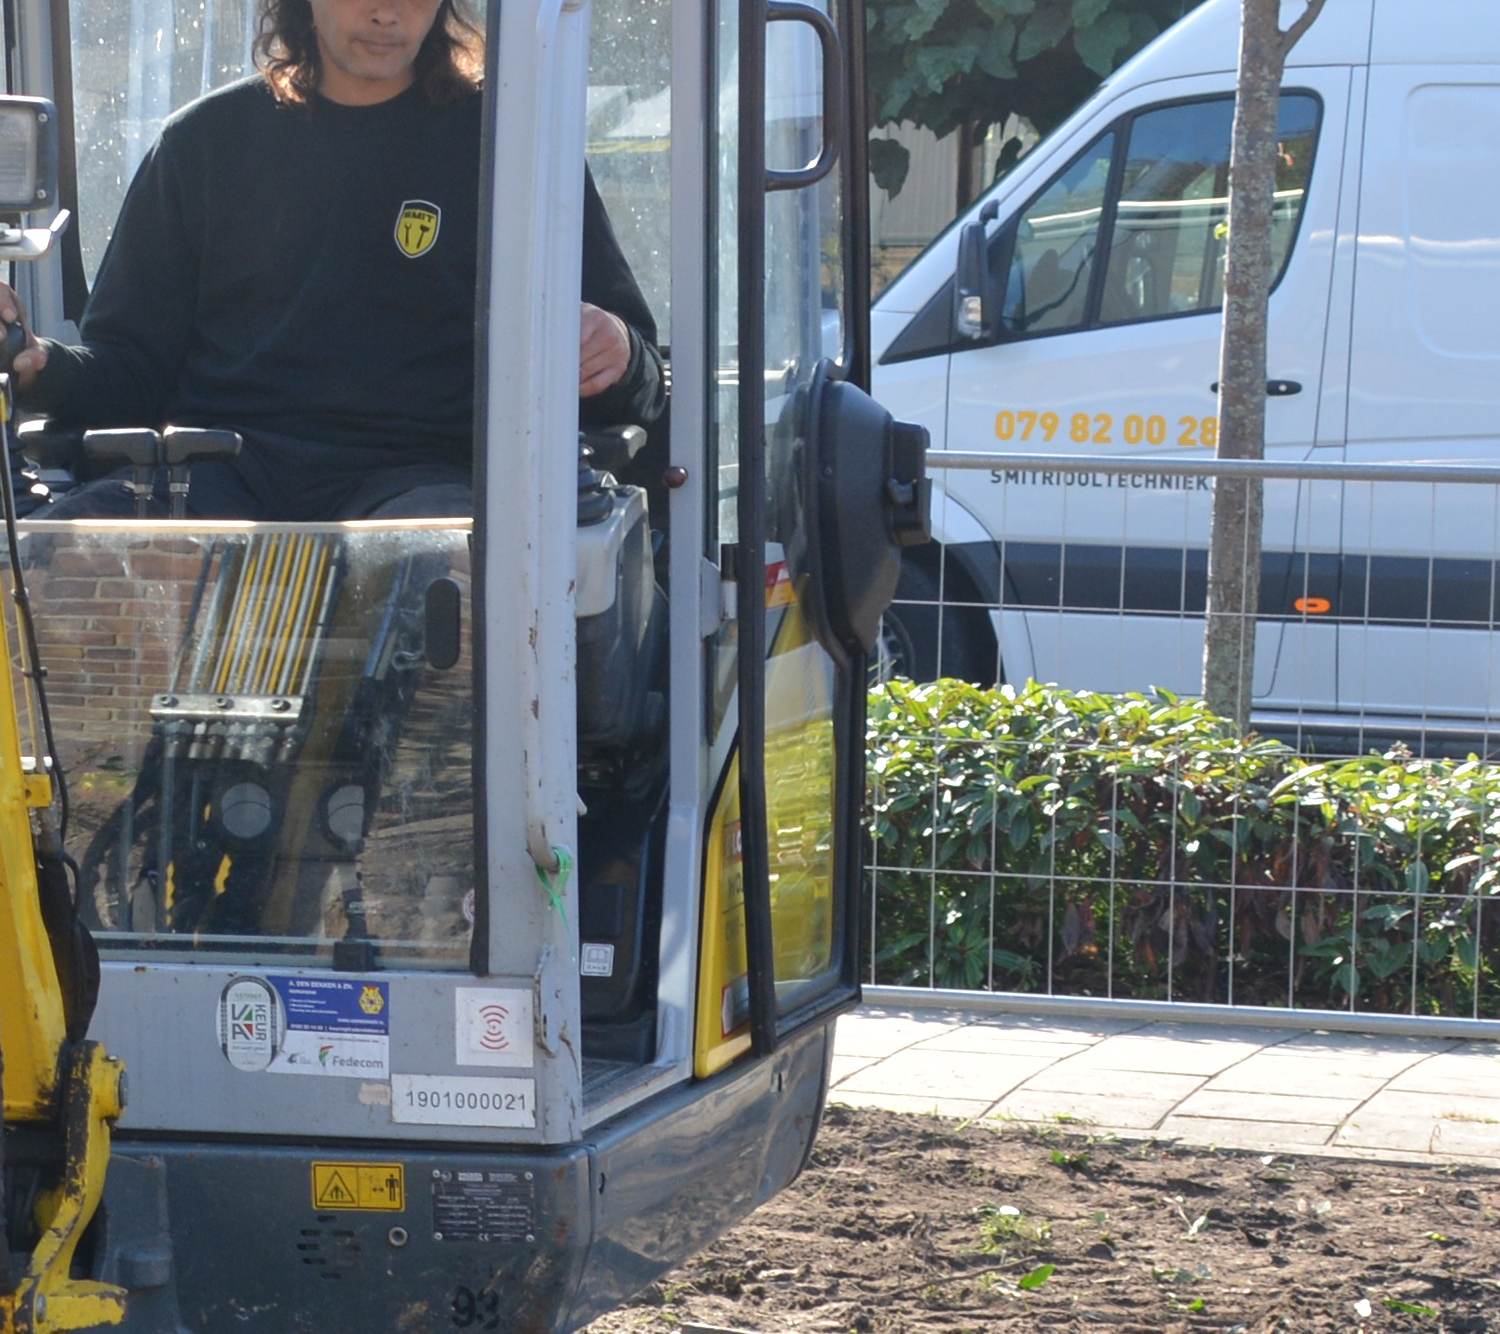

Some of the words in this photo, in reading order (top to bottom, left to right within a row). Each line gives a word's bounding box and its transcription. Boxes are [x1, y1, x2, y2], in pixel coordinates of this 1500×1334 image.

[995, 410, 1060, 442] 079
[1069, 412, 1113, 444] 82
[1123, 414, 1167, 446] 00
[254, 1004, 268, 1042] KEUR
[332, 1055, 384, 1069] Fedecom
[405, 1090, 527, 1111] 1901000021
